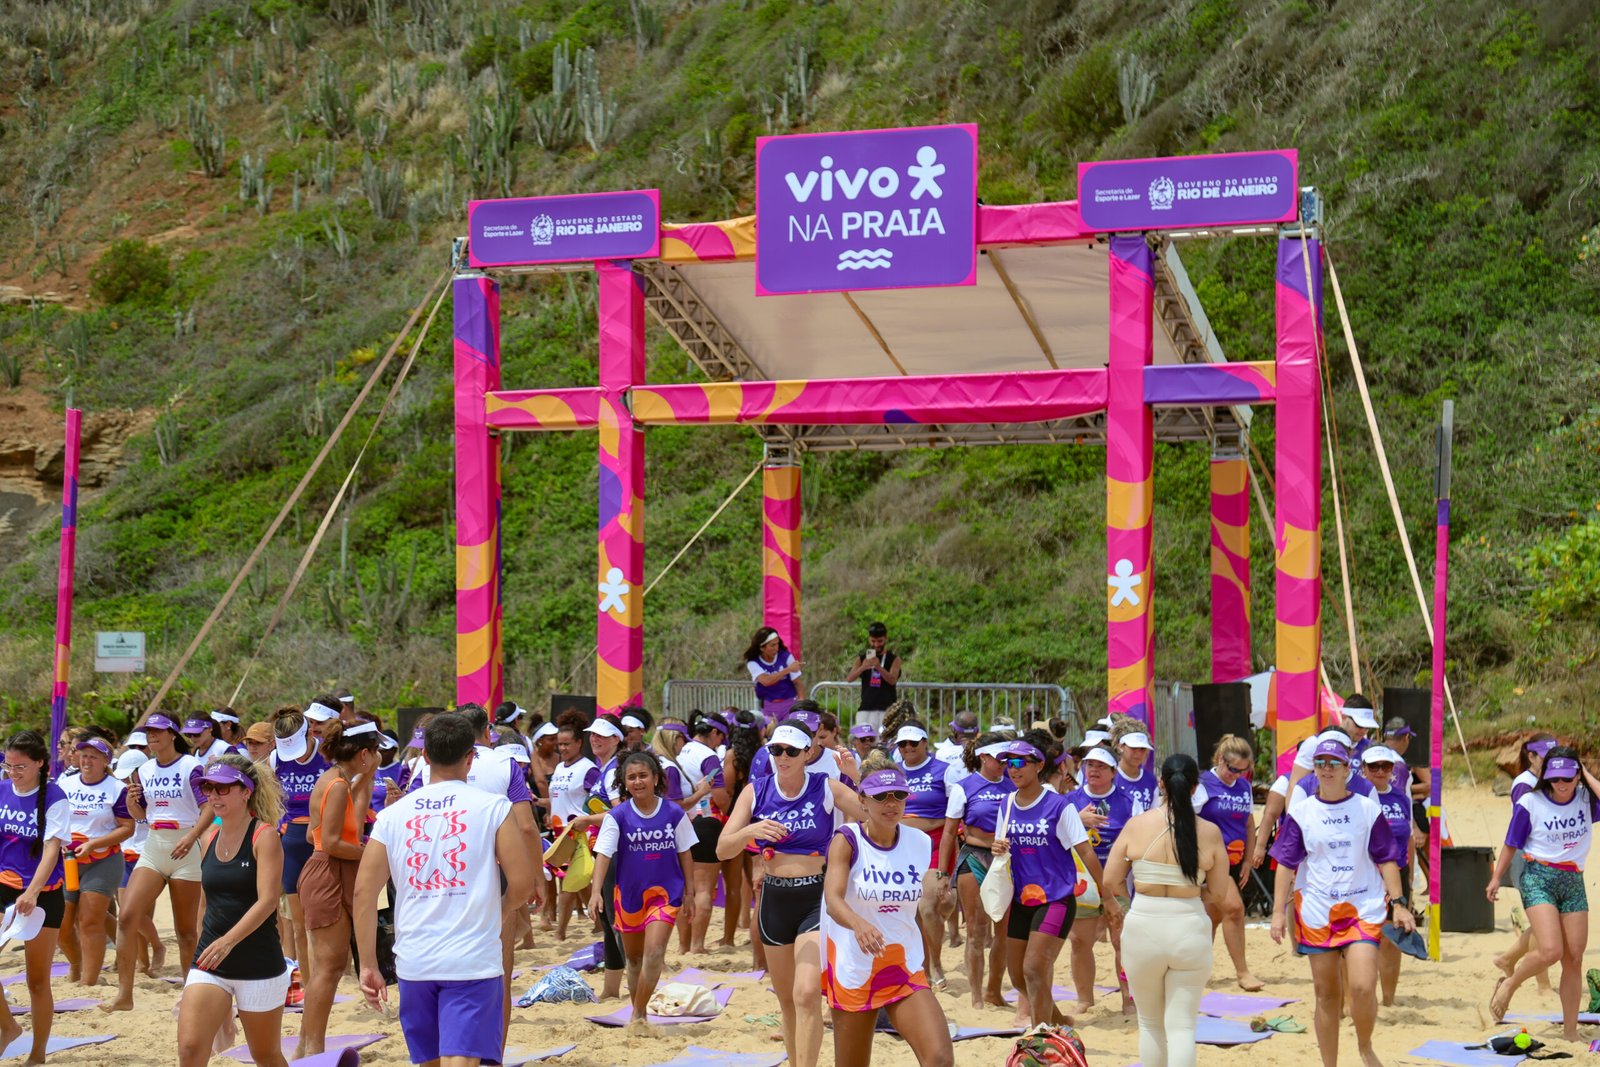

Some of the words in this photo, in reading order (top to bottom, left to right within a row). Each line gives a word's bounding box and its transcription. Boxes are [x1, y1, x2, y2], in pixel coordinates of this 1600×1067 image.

[785, 156, 899, 202] vivo
[1177, 179, 1221, 189] GOVERNO
[1225, 178, 1238, 186] DO
[1242, 176, 1278, 185] ESTADO
[1095, 188, 1126, 196] Secretaria
[1095, 195, 1119, 203] Esporte
[1124, 193, 1141, 201] Lazer
[1177, 187, 1202, 200] RIO
[1203, 186, 1220, 198] DE
[1222, 183, 1278, 197] JANEIRO
[555, 217, 594, 226] GOVERNO
[611, 214, 643, 222] ESTADO
[788, 212, 833, 242] NA
[841, 207, 946, 240] PRAIA
[483, 224, 511, 232] Secretaria
[511, 223, 517, 231] de
[509, 229, 524, 237] Lazer
[555, 224, 577, 237] RIO
[577, 224, 593, 235] DE
[594, 221, 643, 234] JANEIRO
[145, 774, 170, 788] vivo
[281, 772, 315, 784] vivo
[154, 790, 183, 799] PRAIA
[909, 785, 933, 793] RAIA
[68, 789, 95, 803] vivo
[414, 795, 457, 811] Staff
[1217, 802, 1232, 811] NA
[783, 819, 817, 833] RAIA
[1322, 816, 1343, 825] vivo
[1544, 816, 1576, 831] vivo
[4, 823, 39, 838] PRAIA
[626, 827, 663, 842] vivo
[1546, 833, 1561, 843] NA
[1562, 826, 1588, 841] PRAIA
[629, 843, 644, 852] NA
[645, 840, 676, 852] PRAIA
[1019, 836, 1048, 846] PRAIA
[793, 875, 818, 887] DLK
[863, 864, 905, 885] vivo
[857, 887, 878, 902] NA
[882, 889, 923, 902] PRAIA
